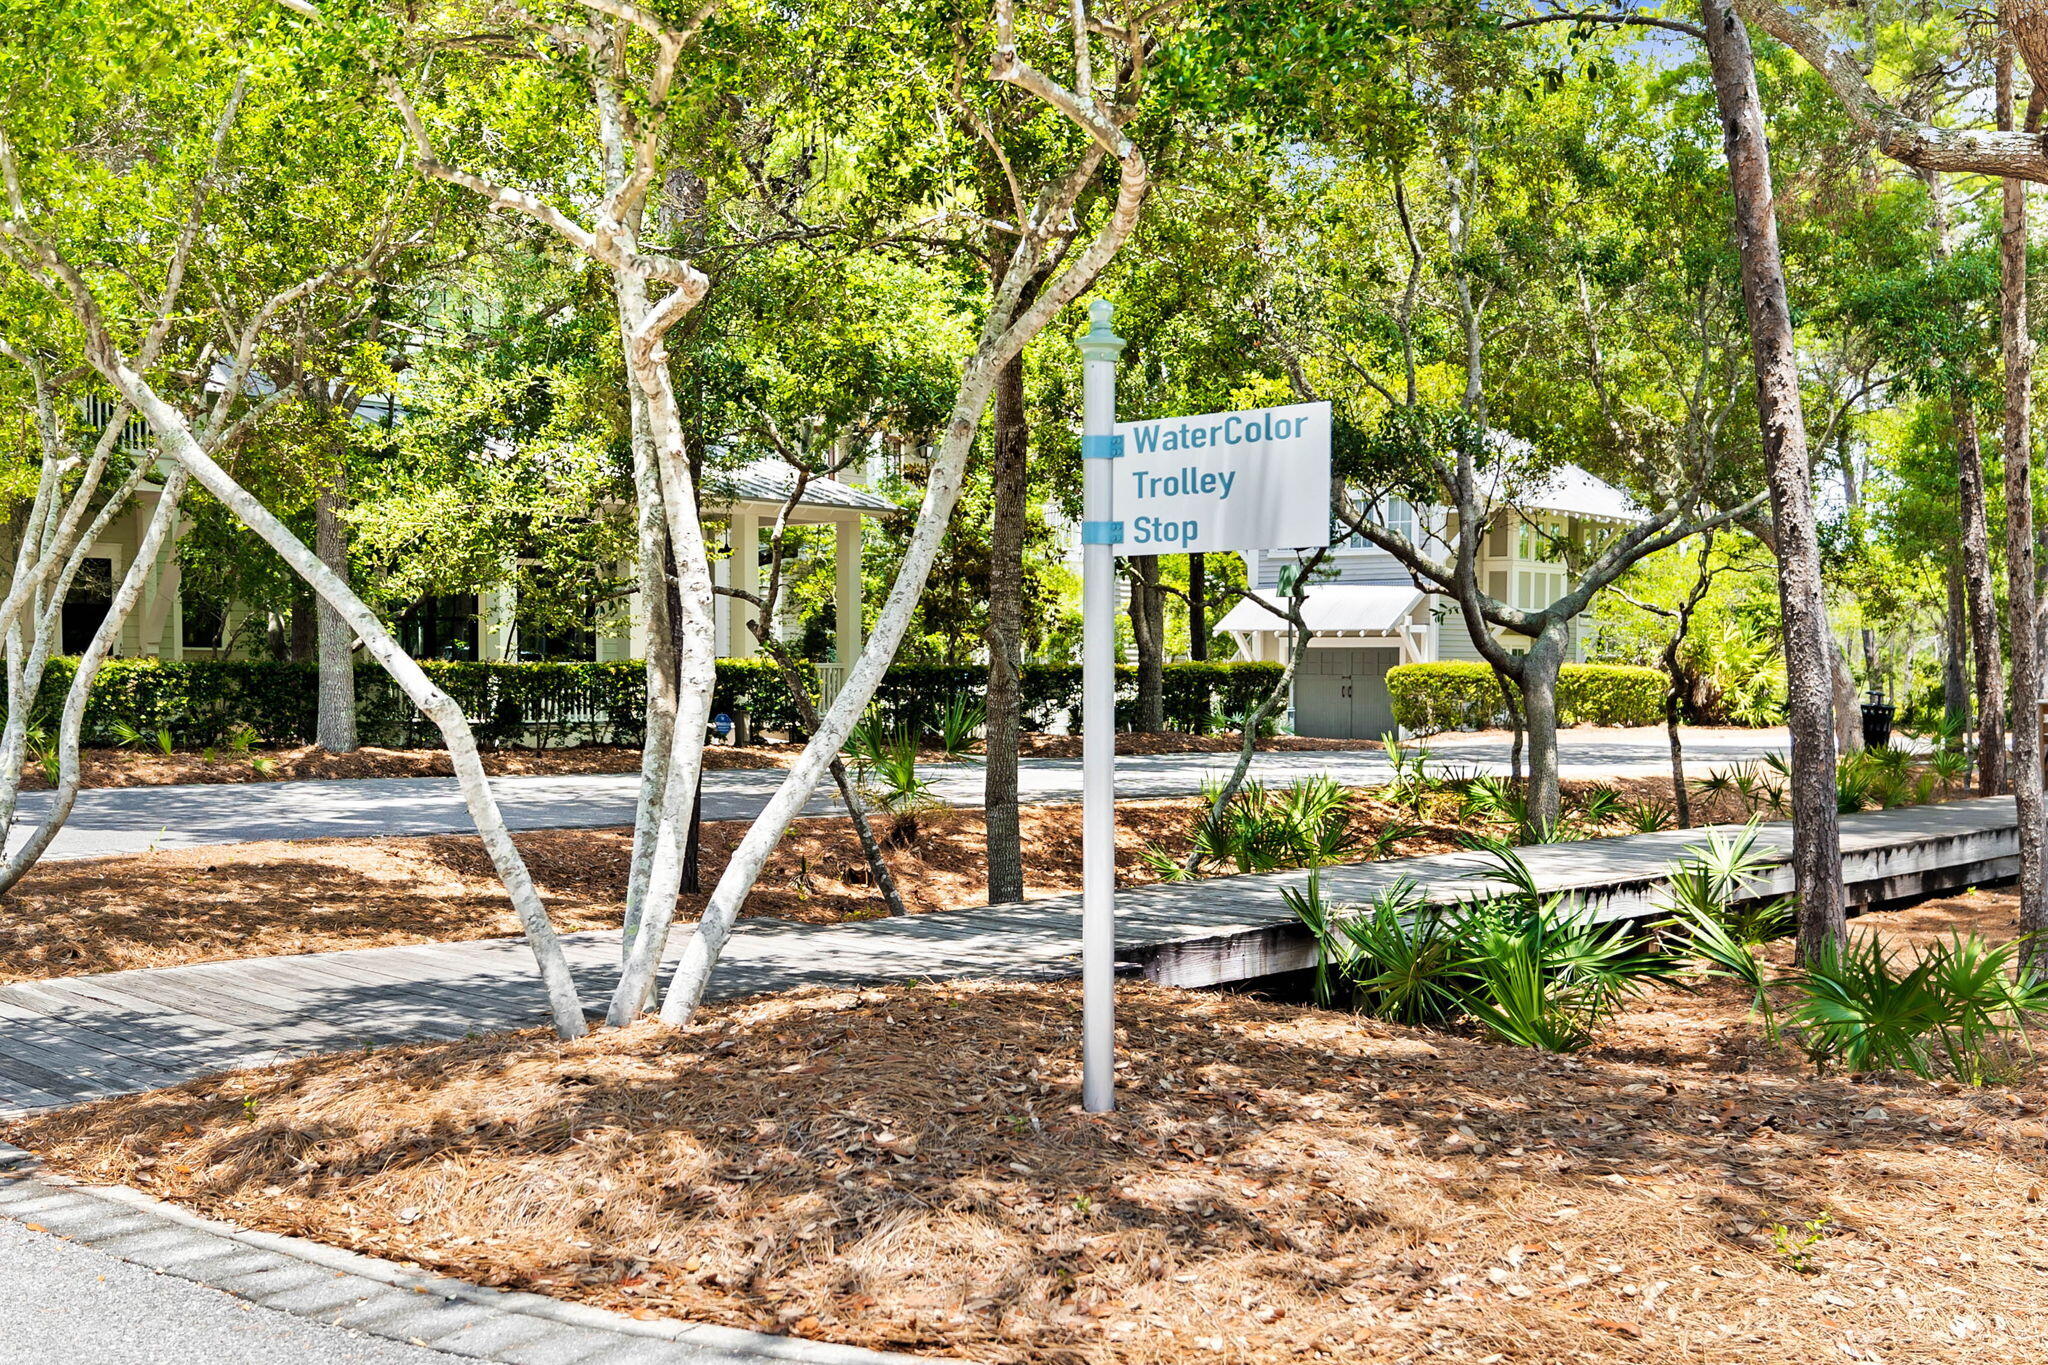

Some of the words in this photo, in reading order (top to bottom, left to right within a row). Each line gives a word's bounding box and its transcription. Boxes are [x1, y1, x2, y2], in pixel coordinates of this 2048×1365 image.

[1133, 412, 1309, 454] WaterColor
[1132, 466, 1236, 500] Trolley
[1133, 516, 1198, 549] Stop
